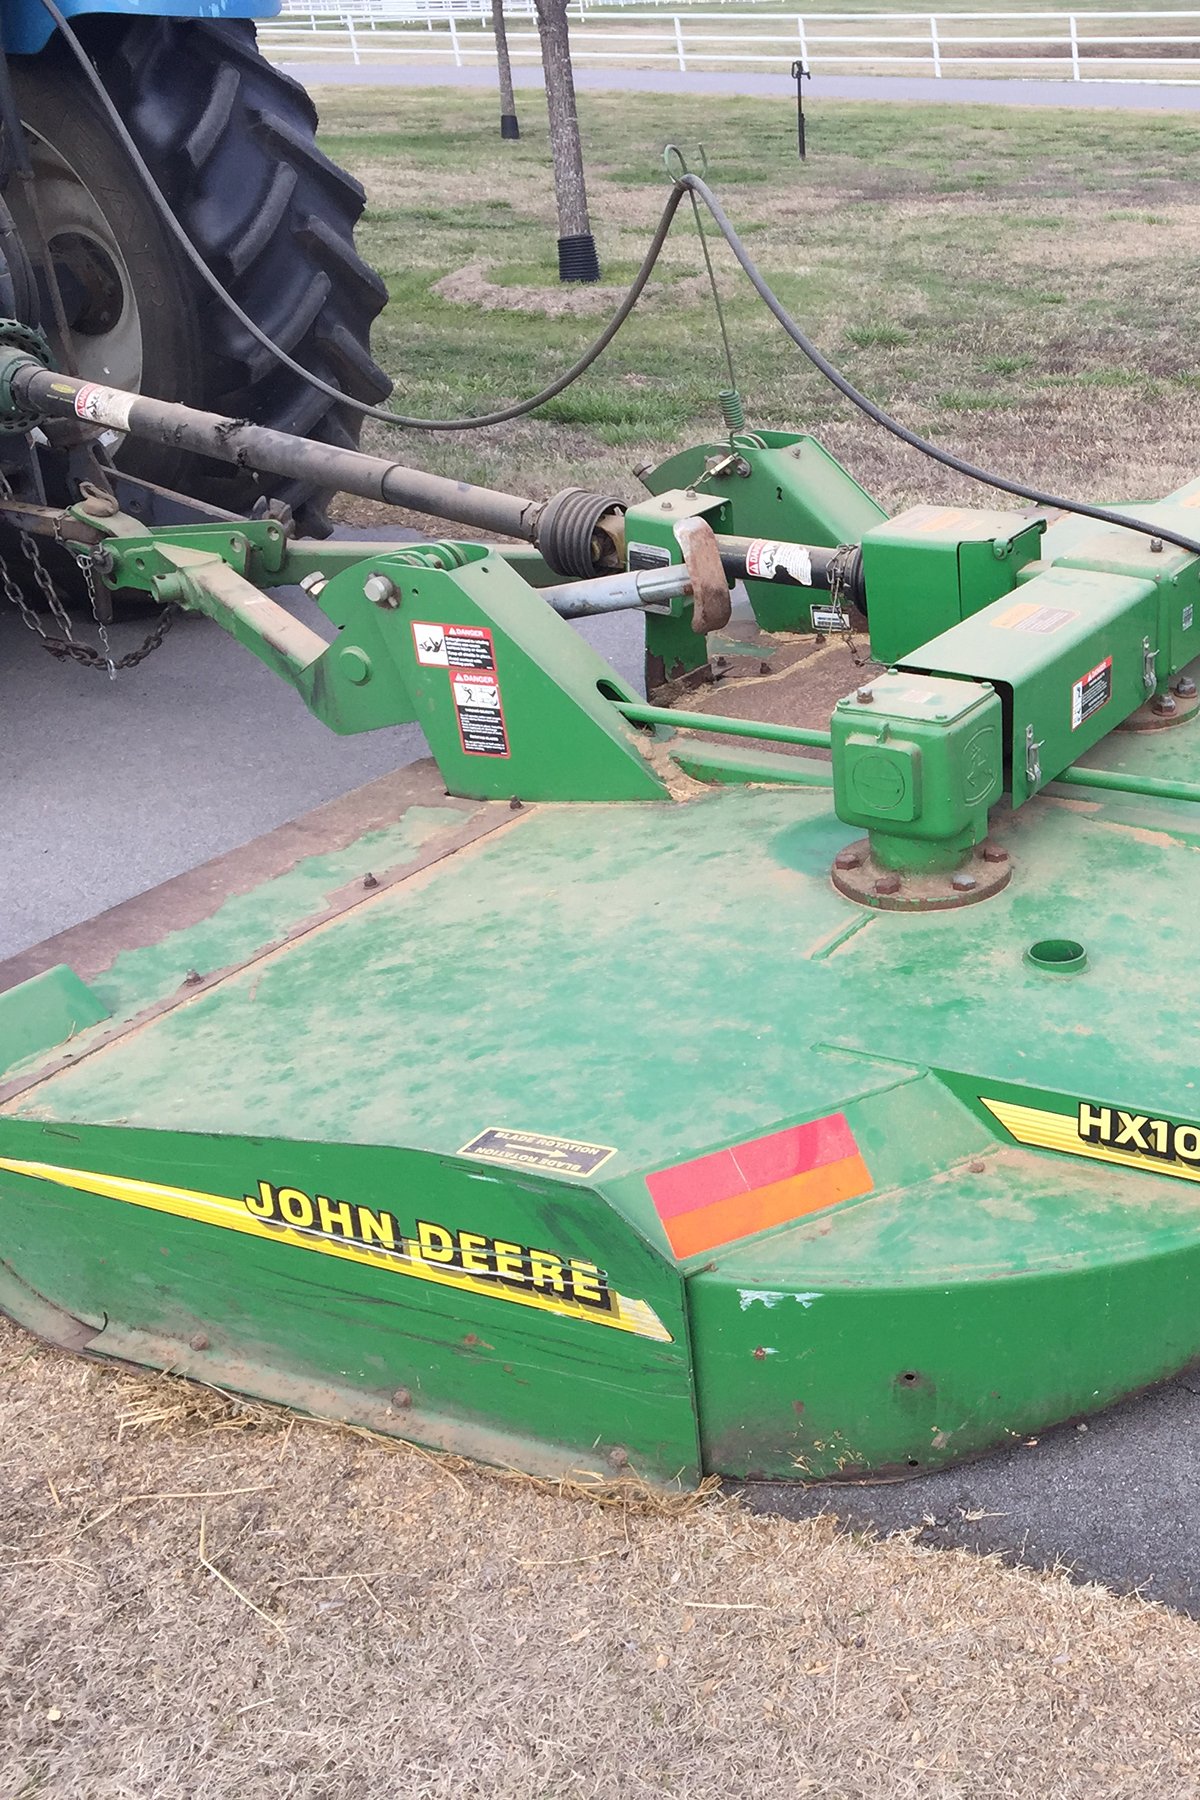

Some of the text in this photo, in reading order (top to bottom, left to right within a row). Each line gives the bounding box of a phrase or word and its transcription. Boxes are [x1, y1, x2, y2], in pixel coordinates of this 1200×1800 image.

[455, 628, 484, 637] DANGER
[463, 674, 494, 684] DANGER
[494, 1131, 600, 1155] BLADE ROTATION
[474, 1146, 582, 1172] BLADE ROTATION
[244, 1180, 604, 1304] JOHN DEERE
